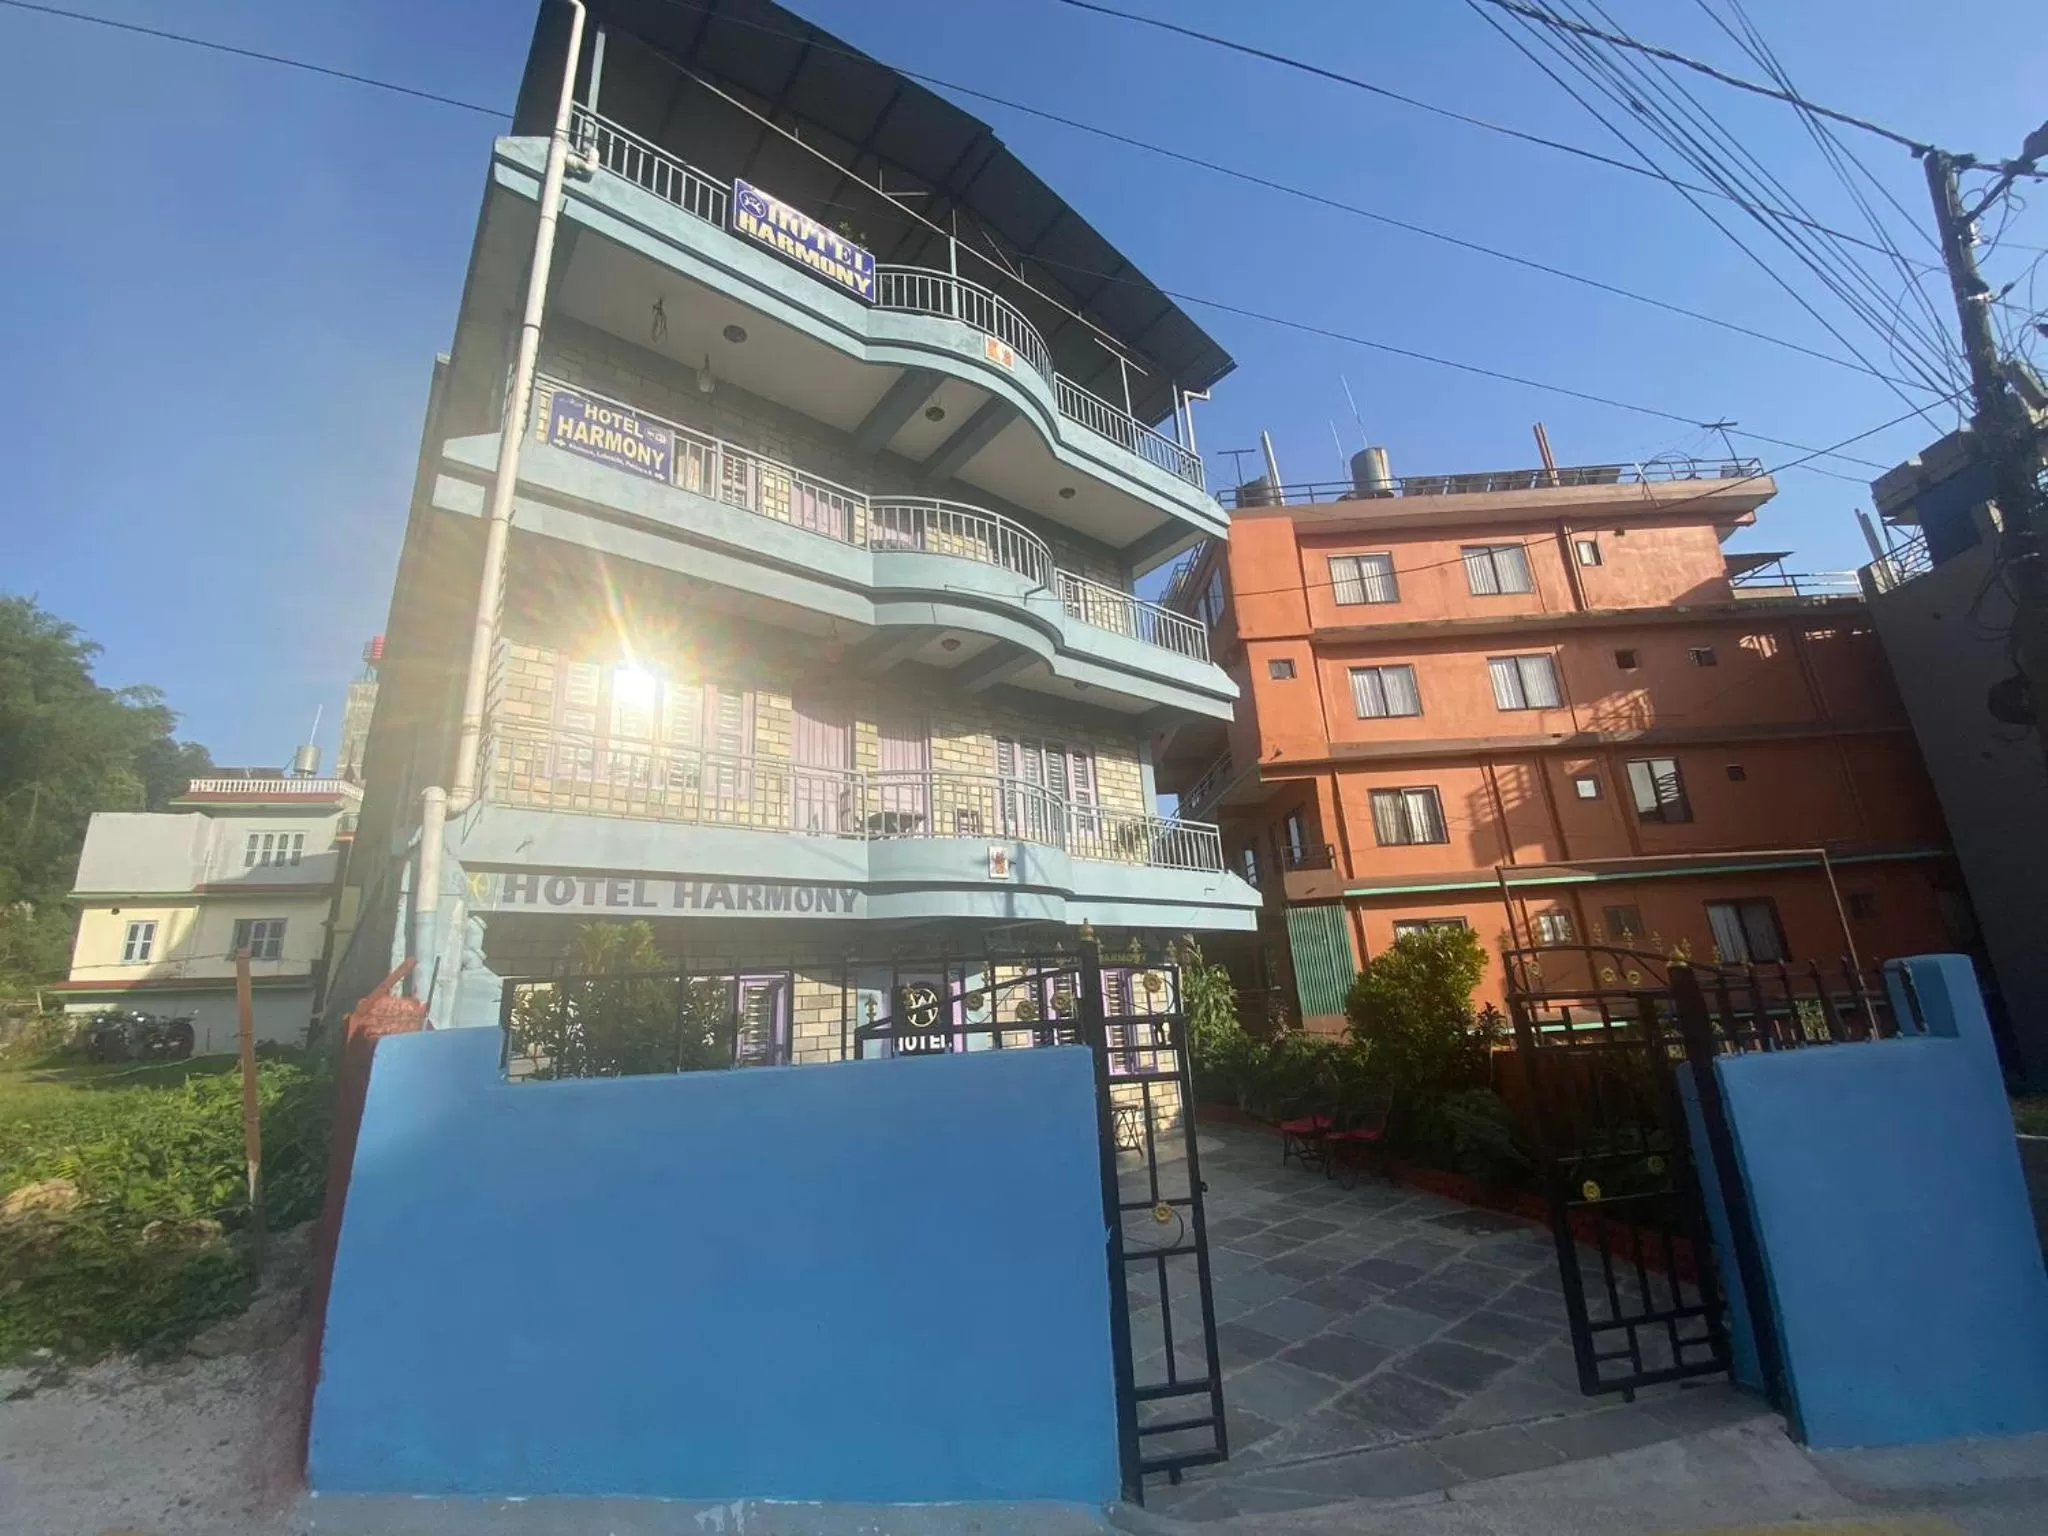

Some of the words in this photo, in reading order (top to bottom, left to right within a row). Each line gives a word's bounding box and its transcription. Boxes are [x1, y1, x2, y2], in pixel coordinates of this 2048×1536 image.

[739, 209, 871, 294] HARMONY
[768, 204, 871, 275] HOTEL
[557, 415, 665, 471] HARMONY
[584, 403, 643, 438] HOTEL
[503, 874, 657, 907] HOTEL
[673, 881, 858, 913] HARMONY
